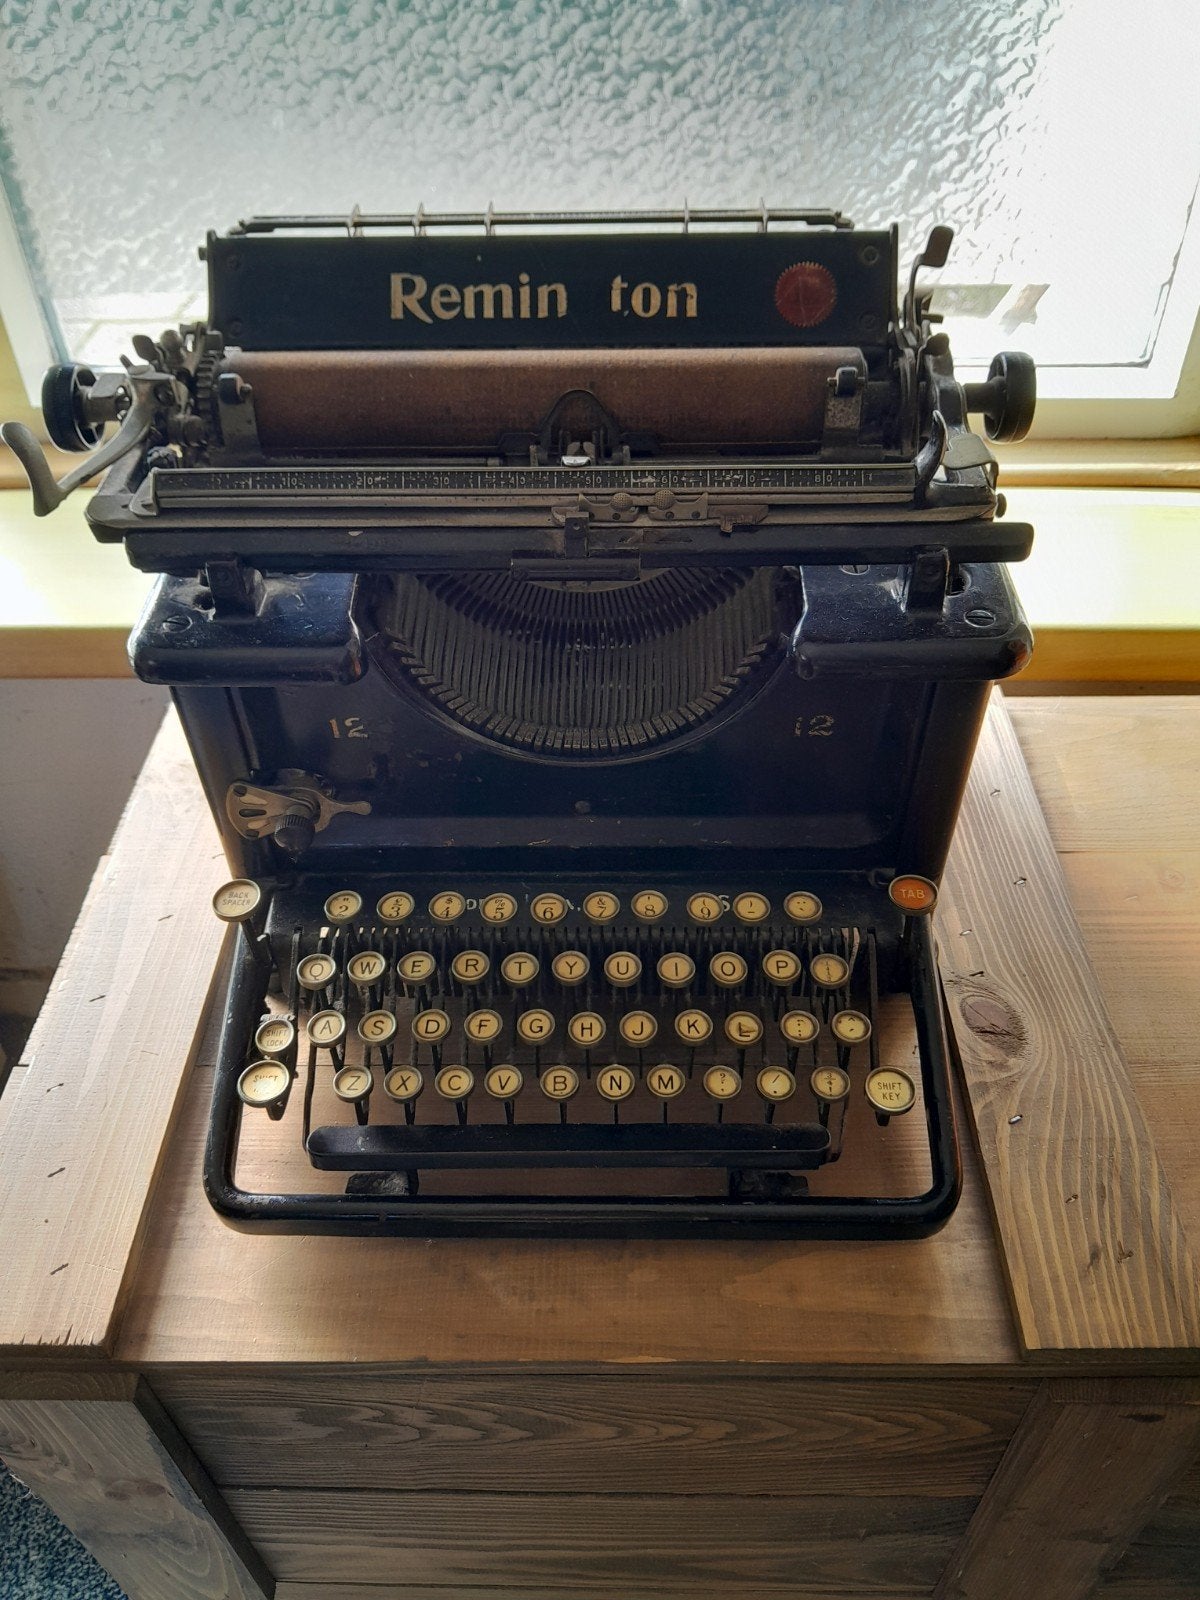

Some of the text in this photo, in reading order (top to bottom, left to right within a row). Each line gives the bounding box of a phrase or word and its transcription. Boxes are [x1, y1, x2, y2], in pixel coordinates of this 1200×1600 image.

[433, 476, 450, 486] 30
[585, 475, 602, 485] 50
[661, 475, 679, 484] 60
[814, 474, 832, 483] 80
[328, 717, 368, 739] 12
[900, 889, 925, 898] TAB
[543, 907, 554, 919] 6
[309, 963, 325, 980] Q
[360, 961, 377, 974] W
[410, 960, 424, 973] E
[465, 958, 479, 972] R
[514, 961, 527, 975] T
[565, 961, 578, 975] Y
[616, 961, 630, 975] U
[720, 961, 736, 976] O
[776, 960, 790, 973] P
[319, 1018, 751, 1038] A S D F G H J K L
[346, 1075, 674, 1091] Z X C V B N M
[877, 1082, 902, 1090] SHIFT
[882, 1092, 900, 1101] KEY
